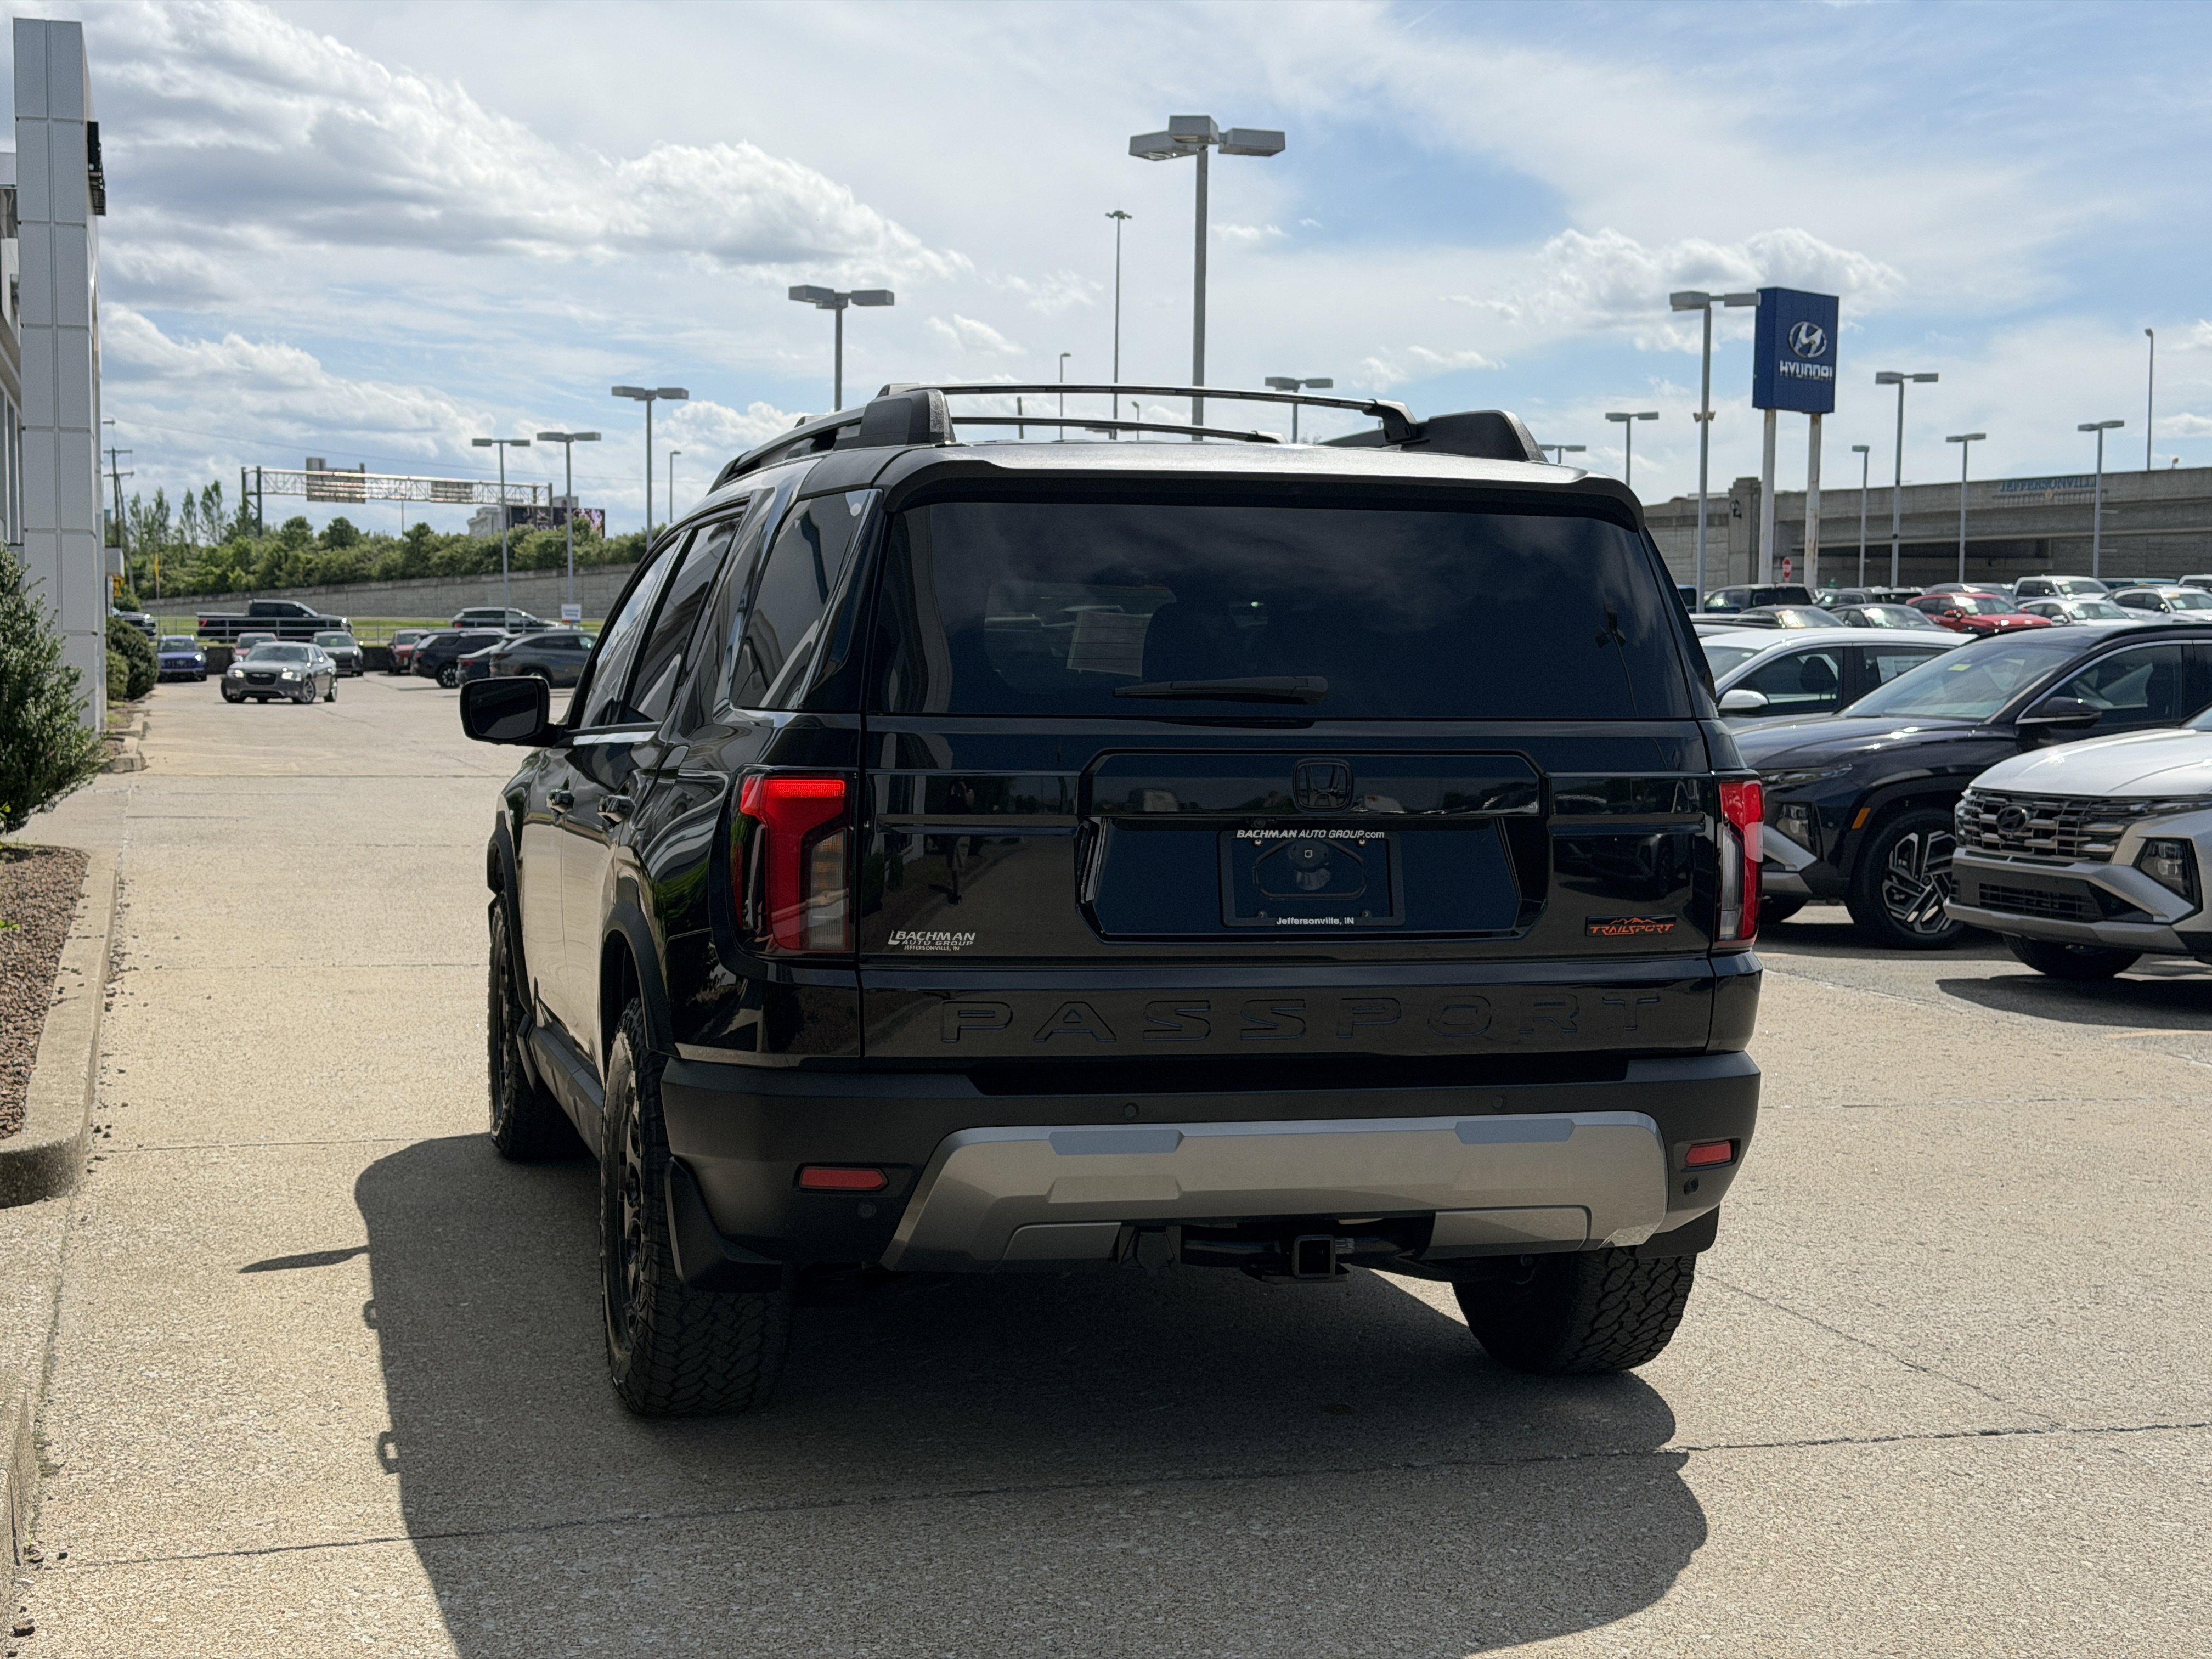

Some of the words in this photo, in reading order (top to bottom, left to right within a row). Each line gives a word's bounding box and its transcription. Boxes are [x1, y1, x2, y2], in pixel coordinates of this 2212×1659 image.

[1780, 360, 1833, 380] HYUNDAI
[1237, 830, 1297, 838] BACHMAN
[1298, 830, 1326, 838] AUTO
[1328, 830, 1385, 839] GROUP.com
[1276, 917, 1342, 926] Jeffersonville,
[1344, 917, 1355, 925] IN
[1589, 924, 1674, 935] TRAILSPORT
[895, 930, 976, 941] BACHMAN
[941, 992, 1660, 1043] PASSPORT
